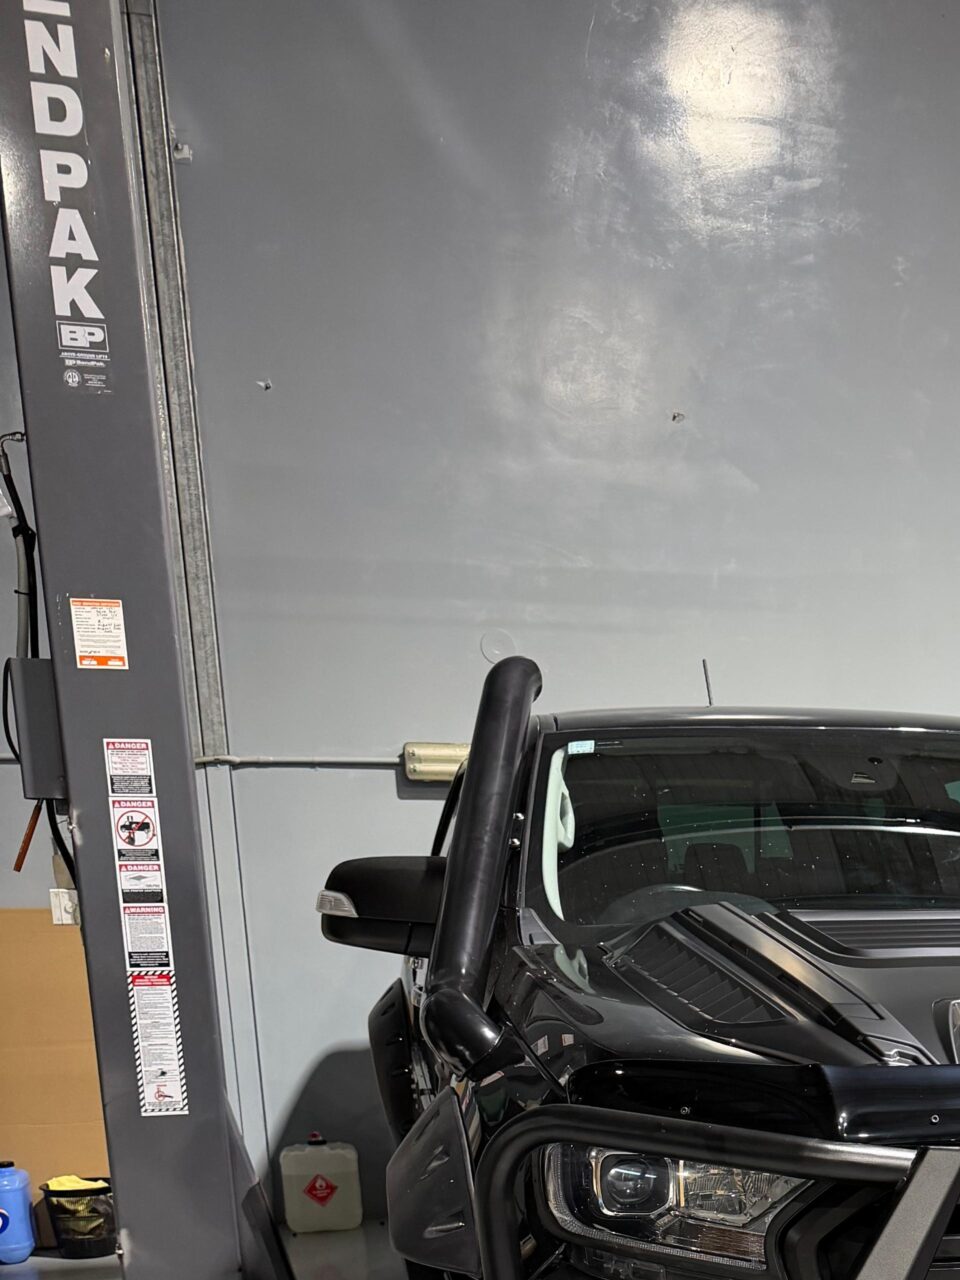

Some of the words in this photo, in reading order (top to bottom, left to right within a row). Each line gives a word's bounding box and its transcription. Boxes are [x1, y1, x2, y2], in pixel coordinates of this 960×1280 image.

[23, 0, 105, 319] NDPAK
[60, 324, 105, 348] BP
[127, 864, 159, 872] DANGER
